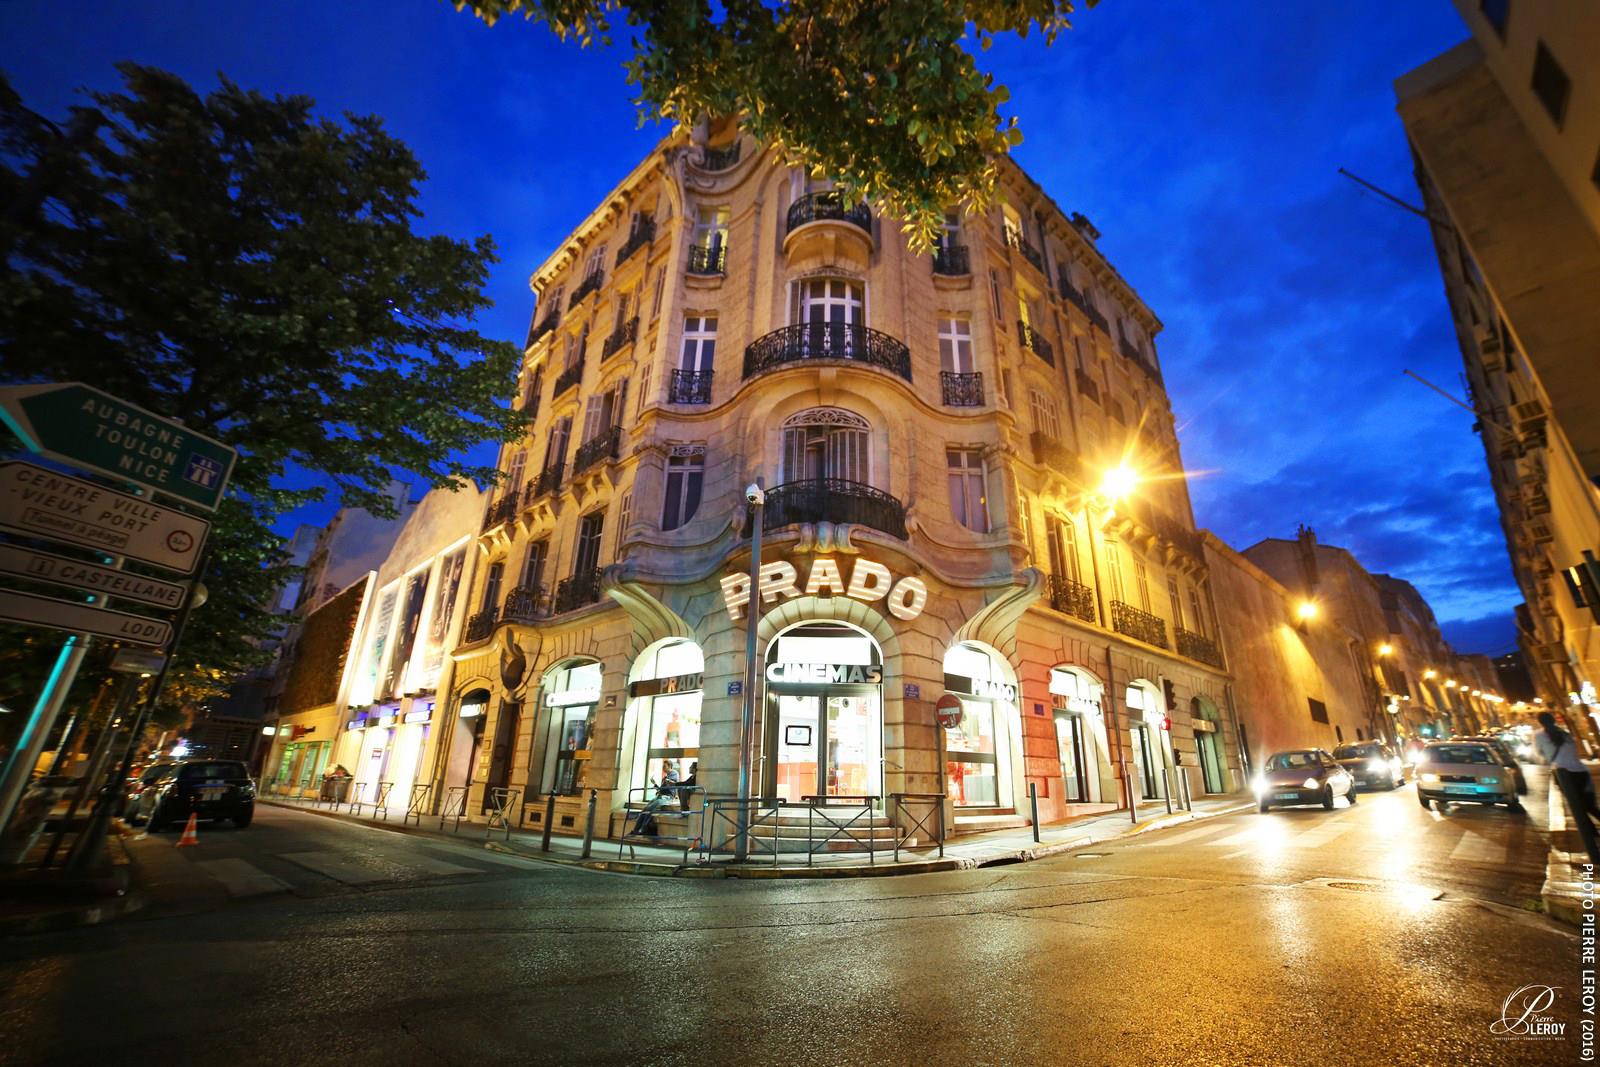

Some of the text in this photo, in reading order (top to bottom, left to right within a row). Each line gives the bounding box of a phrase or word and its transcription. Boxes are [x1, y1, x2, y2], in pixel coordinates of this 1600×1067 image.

[80, 399, 184, 449] AUBAGNE
[95, 423, 177, 466] TOULON
[119, 455, 170, 482] NICE
[16, 470, 161, 521] CENTRE VILLE
[98, 511, 149, 533] PORT
[60, 566, 178, 601] CASTELLANE
[720, 558, 928, 621] PRADO
[121, 620, 162, 638] LODI
[660, 673, 704, 693] PRADO
[766, 662, 881, 683] CINEMAS
